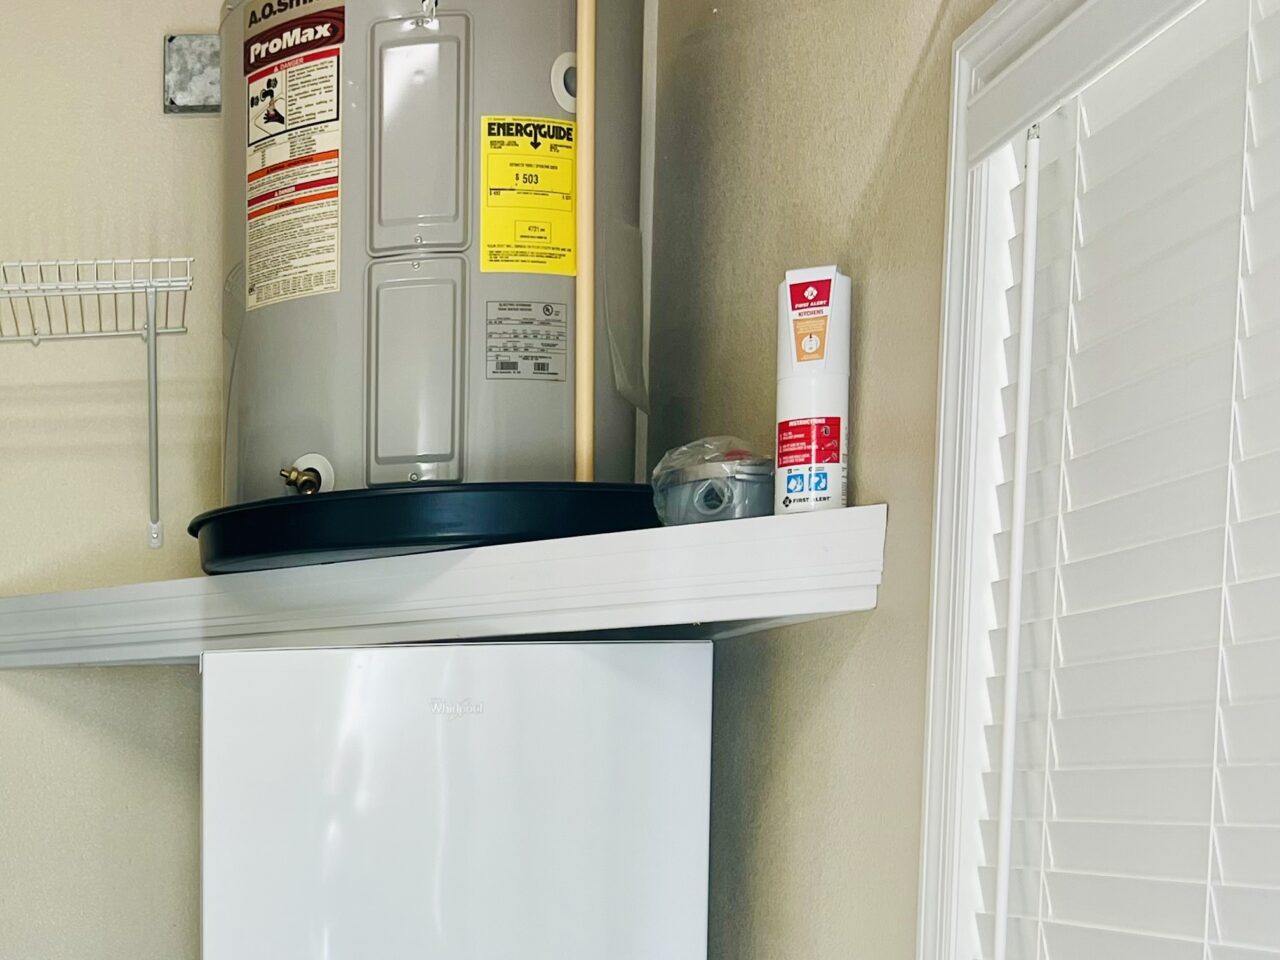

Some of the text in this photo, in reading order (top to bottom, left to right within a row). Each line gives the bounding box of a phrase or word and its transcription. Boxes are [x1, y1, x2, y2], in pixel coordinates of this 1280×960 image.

[249, 23, 331, 64] ProMax
[487, 122, 573, 142] ENERGYGUIDE
[522, 173, 539, 184] 503
[795, 299, 827, 309] FIRST ALERT
[798, 308, 824, 317] KITCHENS
